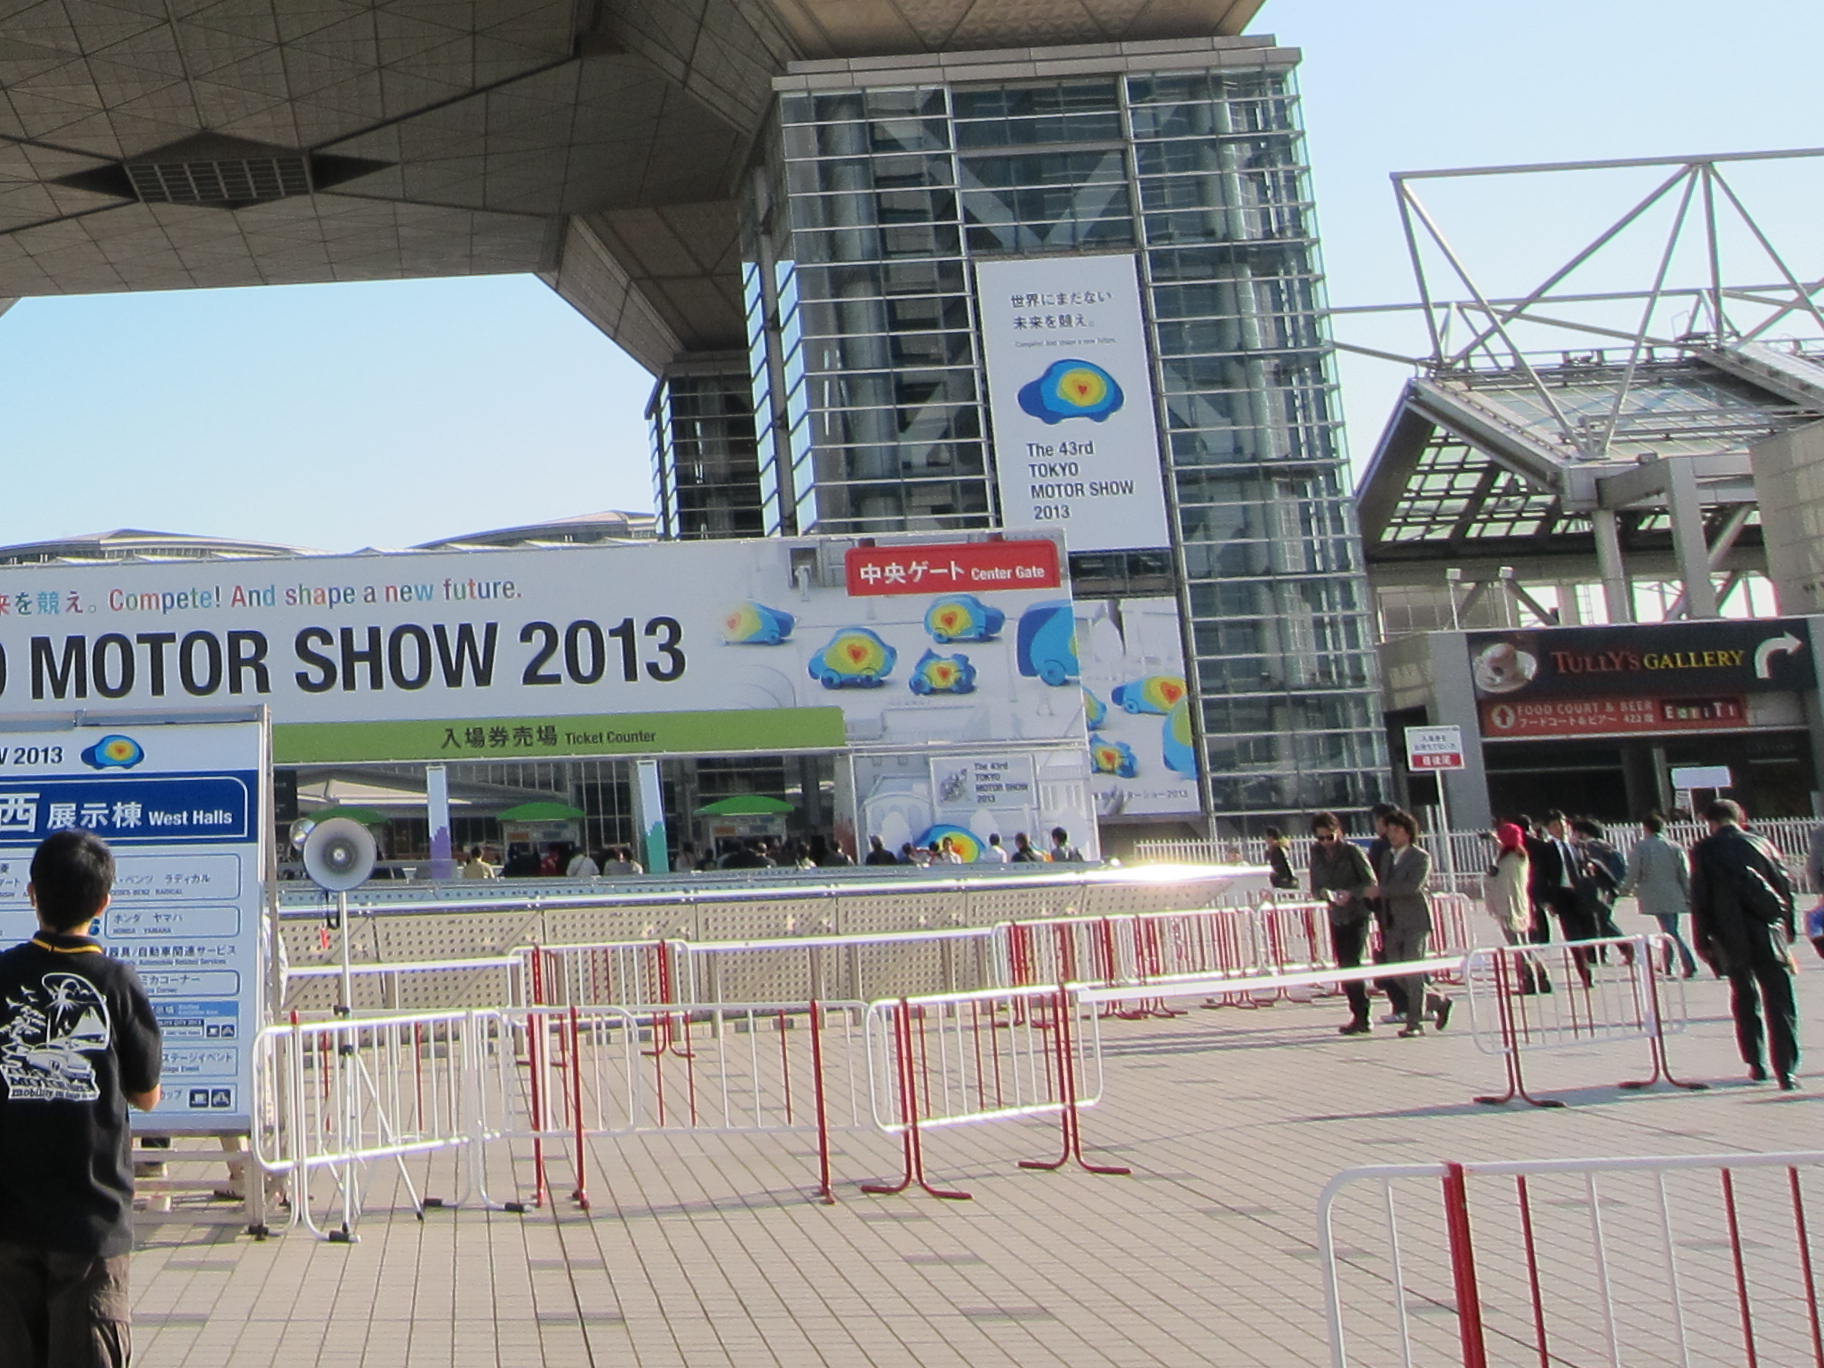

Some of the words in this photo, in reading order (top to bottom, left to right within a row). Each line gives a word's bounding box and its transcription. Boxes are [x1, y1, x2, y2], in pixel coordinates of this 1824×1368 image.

[1026, 442, 1054, 457] The
[1059, 440, 1094, 456] 43rd
[1028, 462, 1079, 478] TOKYO
[1031, 482, 1085, 499] MOTOR
[1089, 480, 1134, 496] SHOW
[1034, 504, 1070, 520] 2013
[860, 560, 965, 584] 中央ゲート
[971, 567, 1012, 581] Center
[1015, 565, 1045, 580] Gate
[109, 583, 222, 615] Compete!
[231, 583, 276, 608] And
[285, 582, 356, 611] shape
[363, 585, 376, 606] a
[385, 583, 435, 604] new
[443, 578, 523, 603] future.
[30, 628, 272, 701] MOTOR
[294, 621, 499, 693] SHOW
[518, 615, 687, 687] 2013
[1643, 649, 1745, 670] GALLERY
[1517, 704, 1553, 715] FOOD
[1557, 702, 1599, 715] COURT
[441, 725, 558, 749] 入場券売場
[565, 731, 604, 745] Ticket
[606, 729, 657, 744] Counter
[13, 746, 63, 765] 2013
[148, 811, 189, 827] West
[192, 809, 233, 825] Halls
[114, 913, 142, 925] ホンダ
[153, 912, 183, 923] ヤマハ
[105, 945, 236, 958] 器具/自動車関連サービス
[141, 974, 201, 986] ミカコーナー
[12, 1088, 53, 1099] mobility
